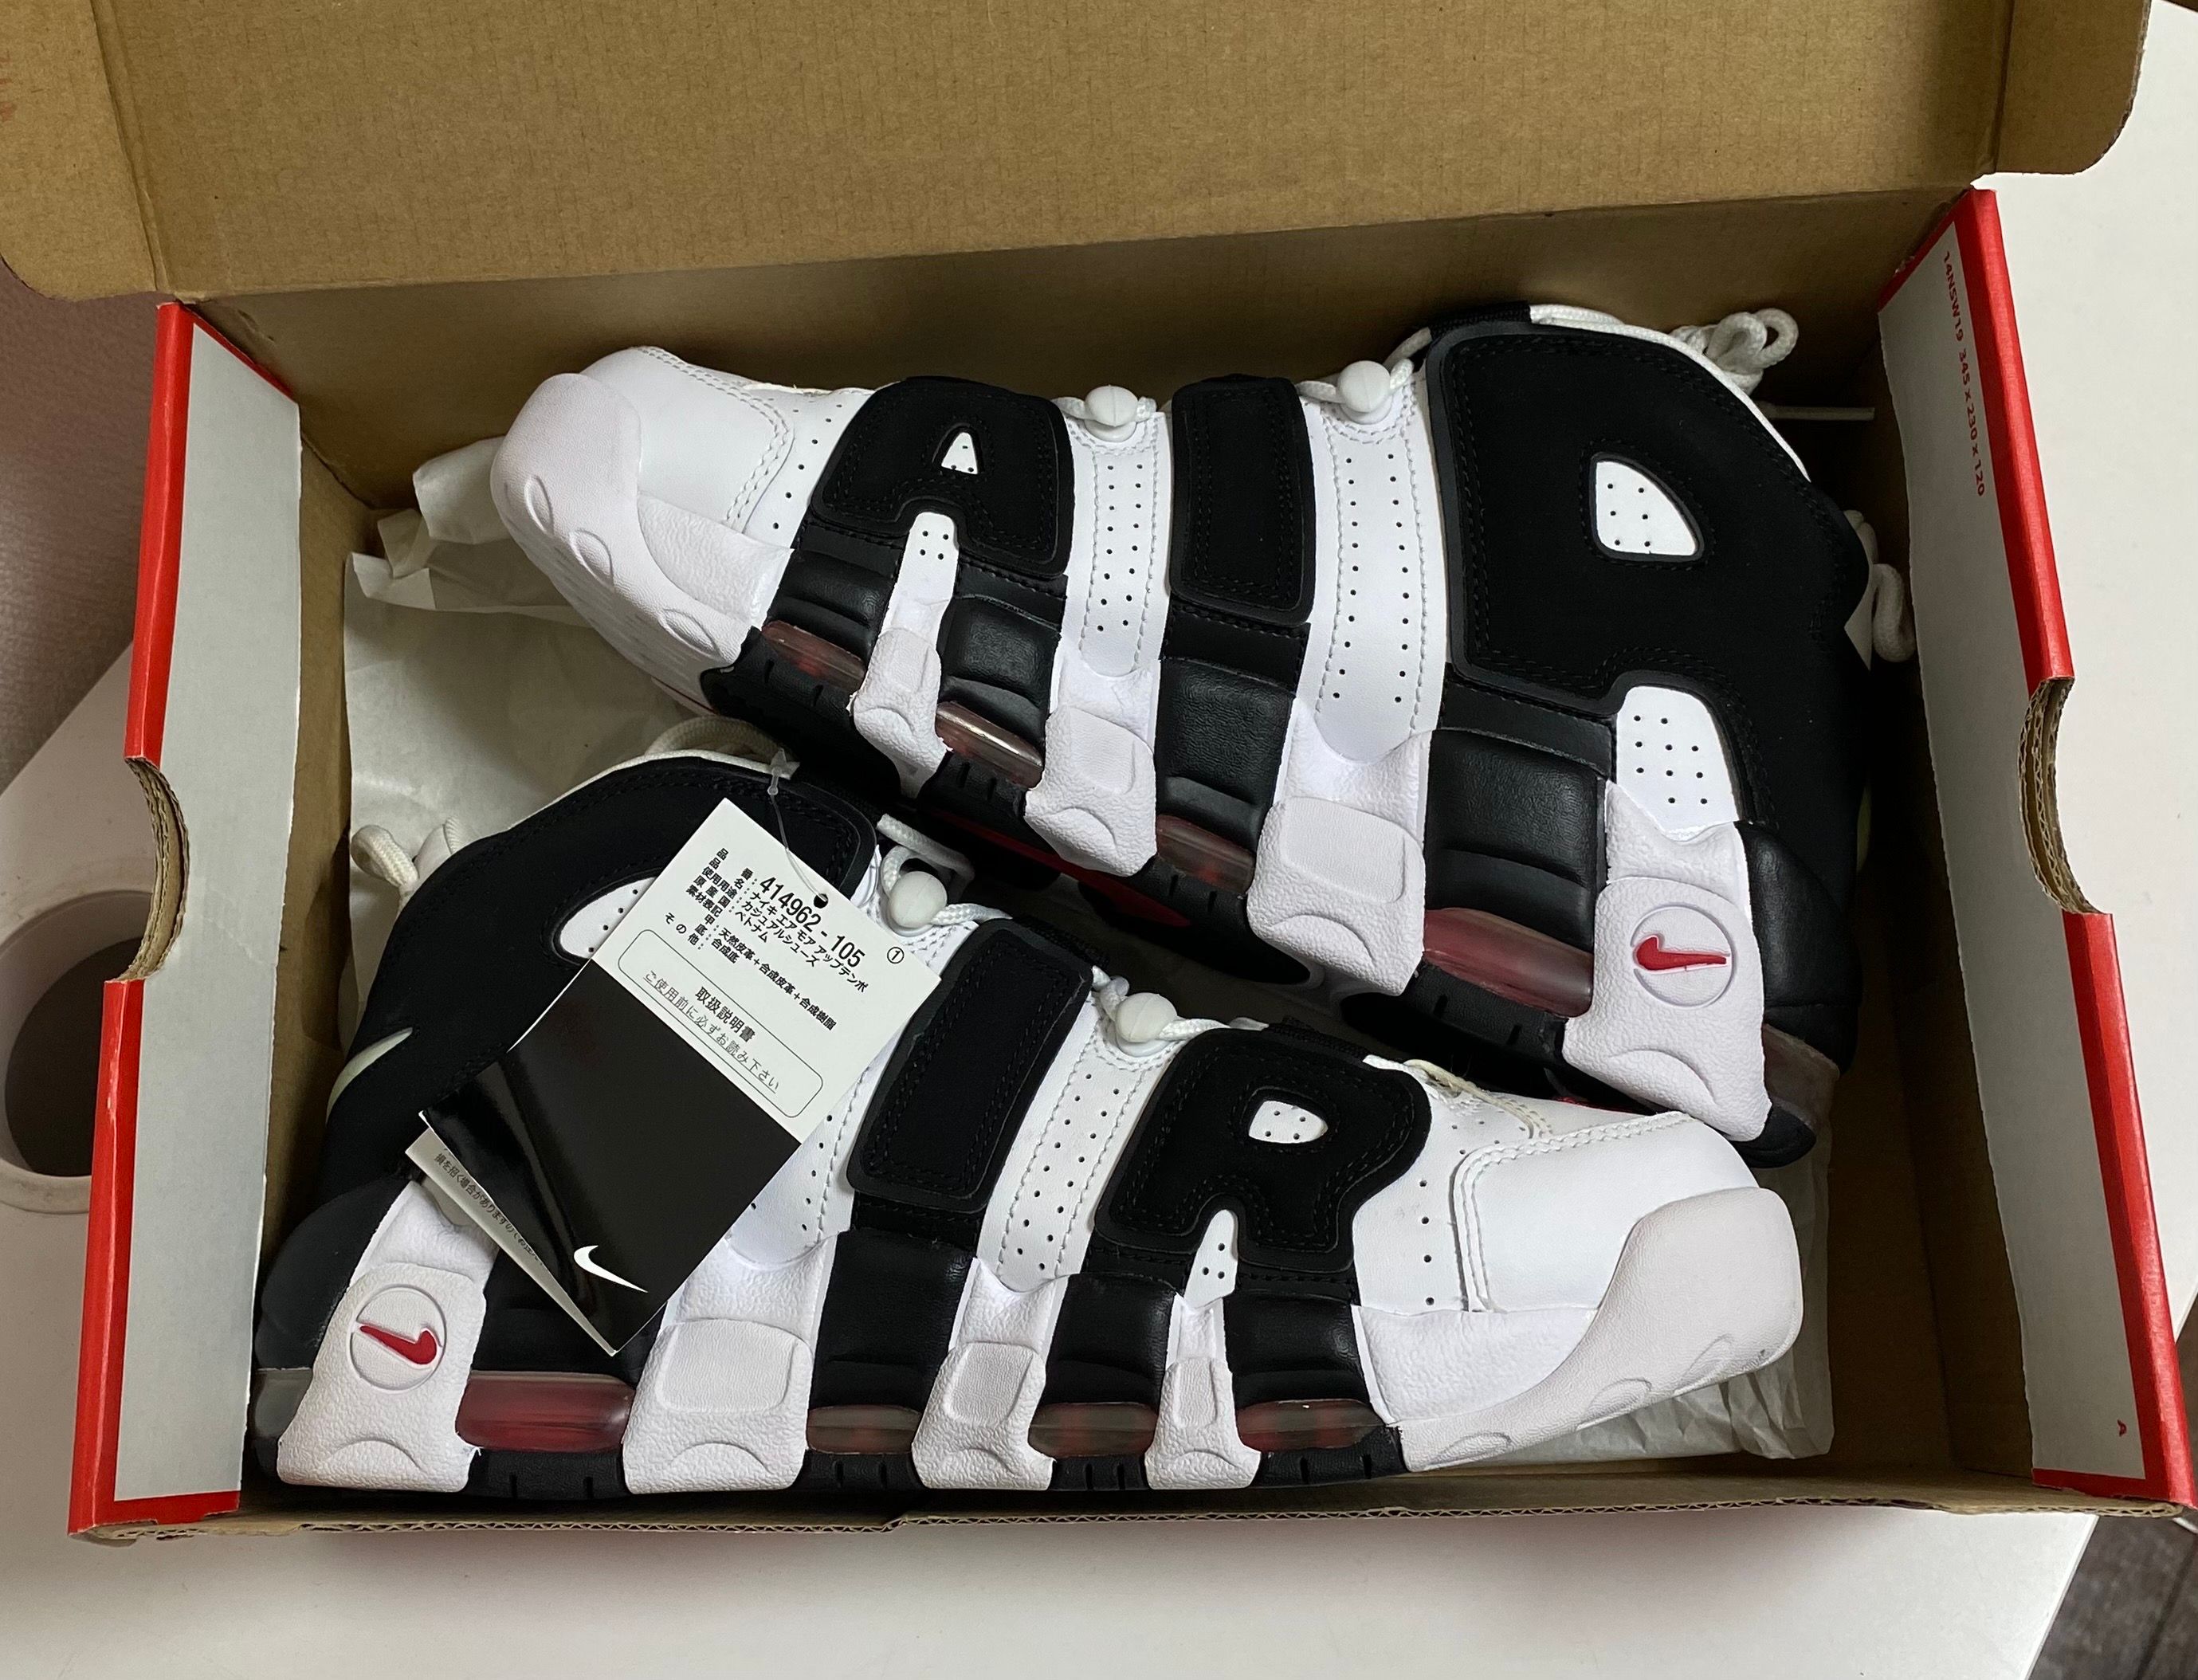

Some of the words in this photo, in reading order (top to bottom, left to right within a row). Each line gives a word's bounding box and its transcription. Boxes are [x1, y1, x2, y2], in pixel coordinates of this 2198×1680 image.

[1943, 250, 1964, 343] 14NSW19
[1957, 348, 1972, 384] 345
[1966, 405, 1980, 442] 230
[1973, 460, 1986, 497] 120
[685, 884, 724, 918] 素材表記
[735, 911, 768, 944] ベトナム
[749, 891, 778, 916] ナイキ
[775, 913, 798, 929] エア
[797, 928, 817, 945] モア
[759, 877, 822, 933] 414962
[830, 935, 865, 968] 105
[711, 938, 740, 964] 合成底
[741, 901, 820, 968] カジュアルシューズ
[643, 971, 779, 1094] ご使用前に必ずお読み下さい
[694, 986, 756, 1042] 取扱説明書
